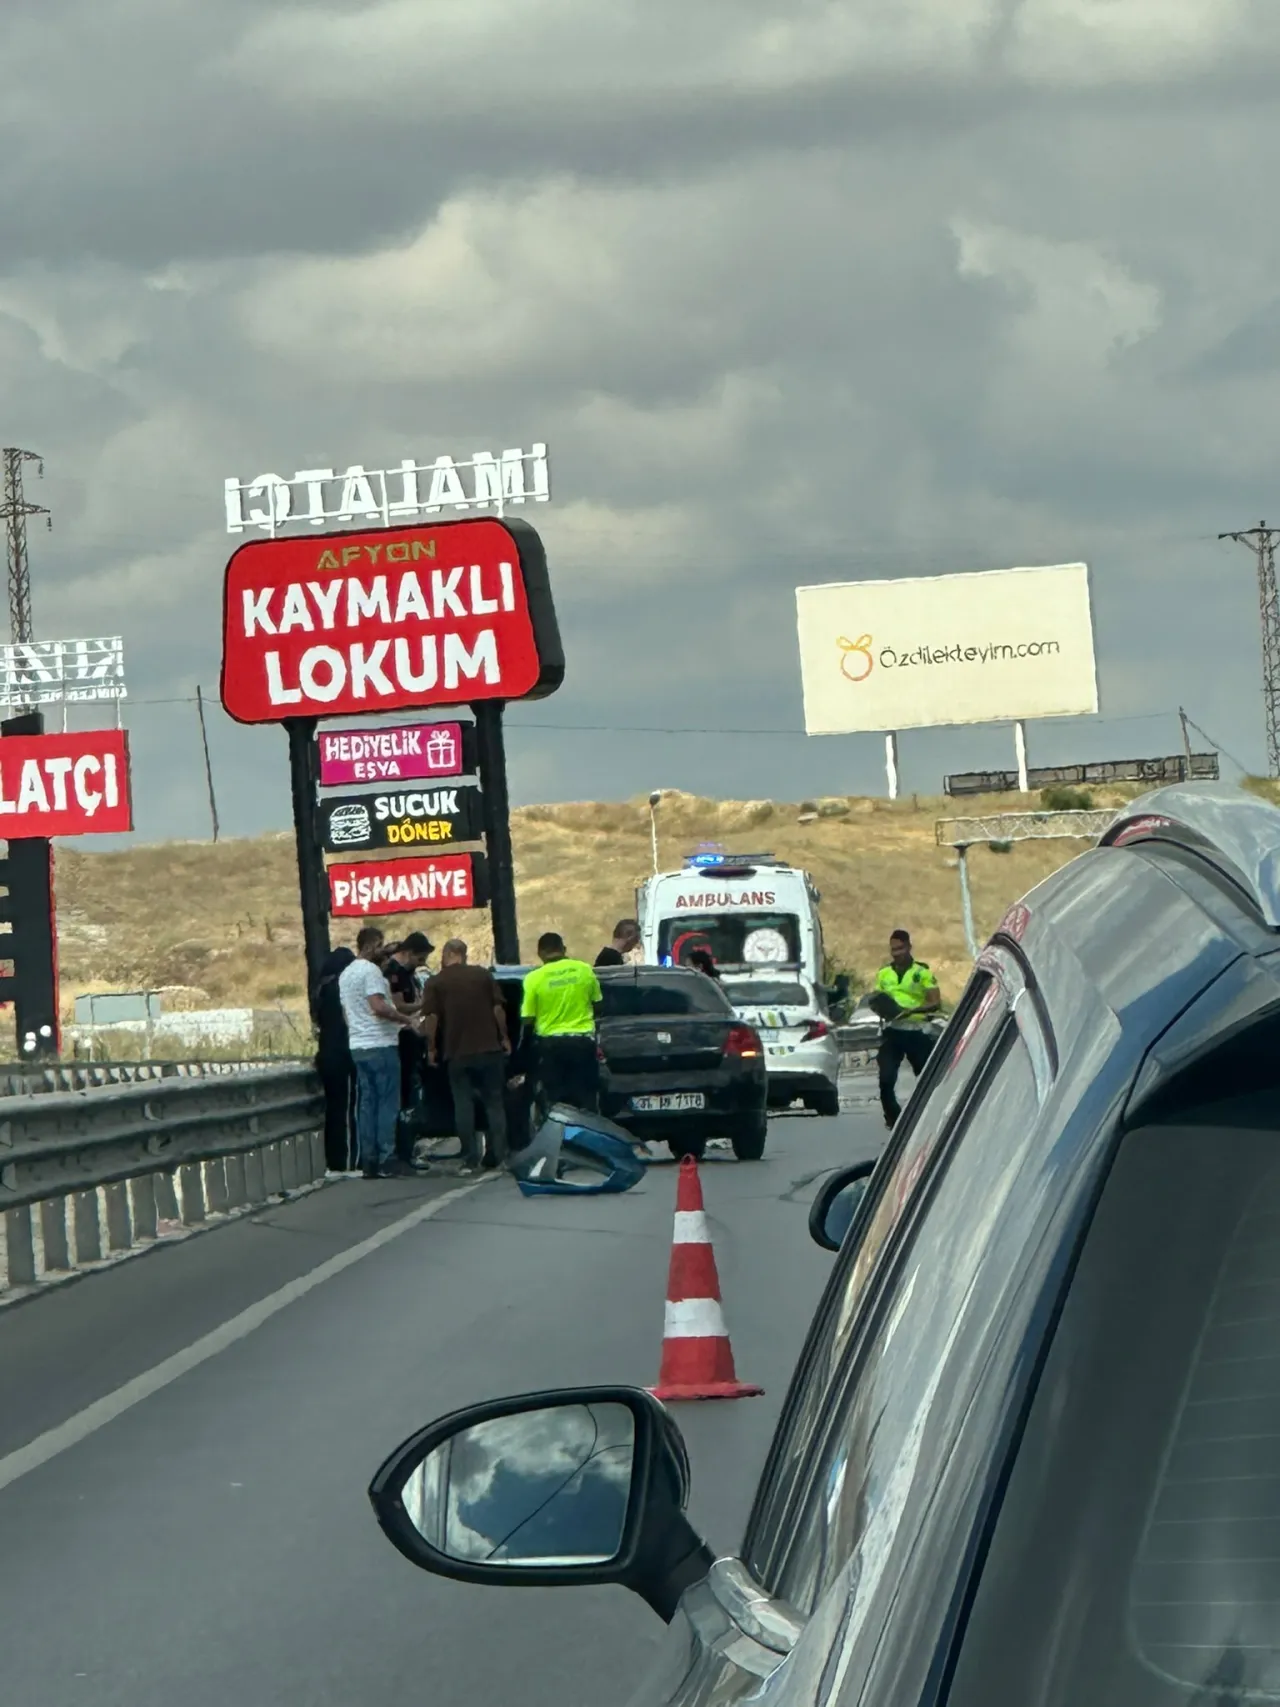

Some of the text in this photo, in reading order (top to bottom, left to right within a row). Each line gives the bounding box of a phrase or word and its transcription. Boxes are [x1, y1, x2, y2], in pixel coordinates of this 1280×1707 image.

[317, 539, 436, 571] AFYON
[242, 562, 515, 637] KAYMAKLI
[265, 629, 500, 705] LOKUM
[879, 640, 1060, 669] Özdilekteyim.com
[374, 790, 460, 820] SUCUK
[387, 818, 452, 843] DÖNER
[334, 864, 467, 913] PİŞMANİYE
[675, 891, 776, 909] AMBULANS
